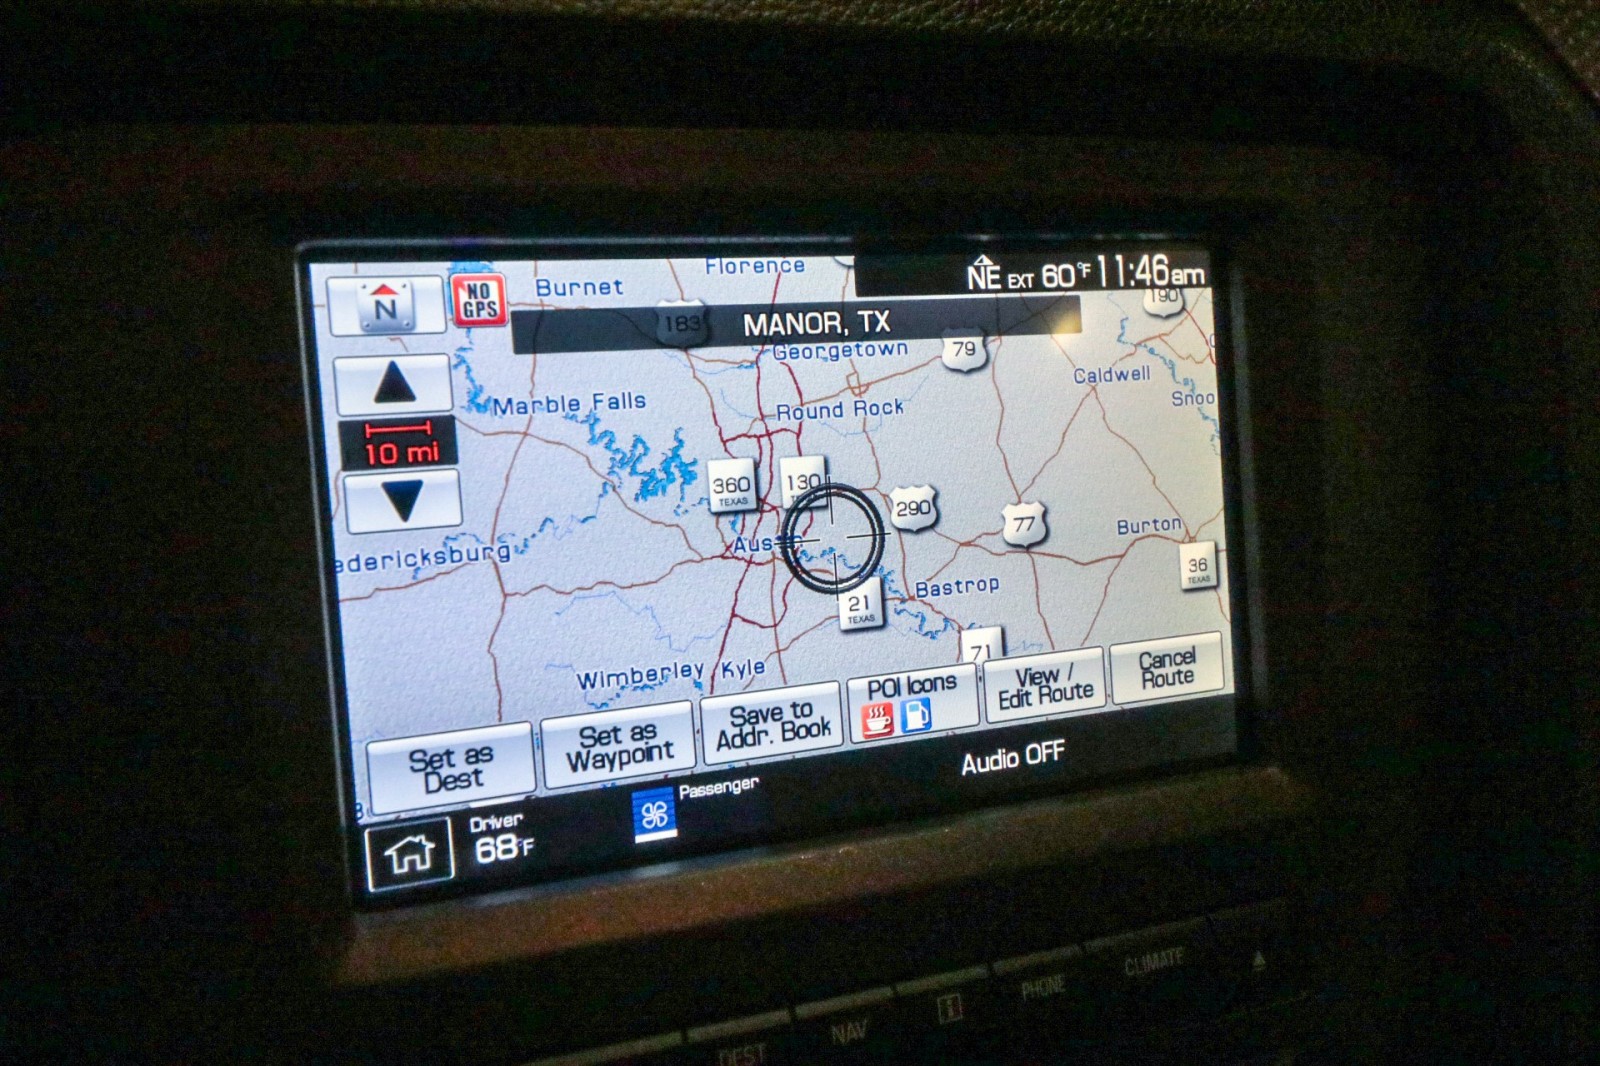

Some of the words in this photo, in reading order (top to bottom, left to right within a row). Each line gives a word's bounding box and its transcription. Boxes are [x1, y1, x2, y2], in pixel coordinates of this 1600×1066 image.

[706, 257, 806, 275] Florence
[1097, 254, 1206, 288] 11:46am
[536, 278, 623, 297] Burnet
[967, 265, 1002, 290] NE
[1008, 273, 1035, 288] EXT
[467, 282, 491, 300] NO
[374, 299, 397, 320] N
[463, 300, 498, 319] GPS
[665, 313, 700, 333] 183
[743, 311, 849, 338] MANOR,
[857, 309, 892, 333] TX
[772, 342, 909, 362] Georgetown
[952, 340, 976, 358] 79
[1073, 365, 1151, 385] Caldwell
[493, 395, 581, 417] Marble
[593, 391, 647, 412] Falls
[1171, 390, 1216, 407] Snoo
[777, 403, 844, 422] Round
[854, 399, 904, 417] Rock
[365, 442, 398, 466] 10
[407, 440, 440, 463] mi
[712, 475, 751, 495] 360
[787, 473, 822, 491] 130
[718, 496, 749, 507] TEXAS
[896, 499, 932, 518] 290
[1013, 515, 1036, 533] 77
[1117, 517, 1183, 536] Burton
[334, 544, 511, 575] edericksburg
[1188, 557, 1208, 574] 36
[915, 576, 1000, 599] Bastrop
[1187, 574, 1211, 585] TEXAS
[847, 594, 870, 613] 21
[847, 613, 876, 625] TEXAS
[970, 644, 991, 661] 71
[1138, 645, 1197, 671] Cancel
[576, 661, 705, 691] Wimberley
[721, 659, 766, 679] Kyle
[1015, 666, 1060, 688] View
[1141, 668, 1195, 691] Route
[868, 680, 902, 700] POI
[907, 673, 958, 695] Icons
[999, 687, 1033, 711] Edit
[1039, 681, 1095, 707] Route
[730, 704, 784, 729] Save
[791, 701, 814, 720] to
[579, 723, 623, 749] Set
[630, 722, 658, 742] as
[716, 729, 774, 752] Addr.
[782, 716, 832, 743] Book
[408, 746, 456, 774] Set
[464, 745, 495, 766] as
[566, 740, 675, 774] Waypoint
[961, 748, 1019, 777] Audio
[1025, 738, 1066, 766] OFF
[424, 767, 485, 795] Dest
[678, 776, 761, 801] Passenger
[469, 813, 524, 834] Driver
[1124, 946, 1185, 977] CLIMATE
[830, 1019, 869, 1046] NAV
